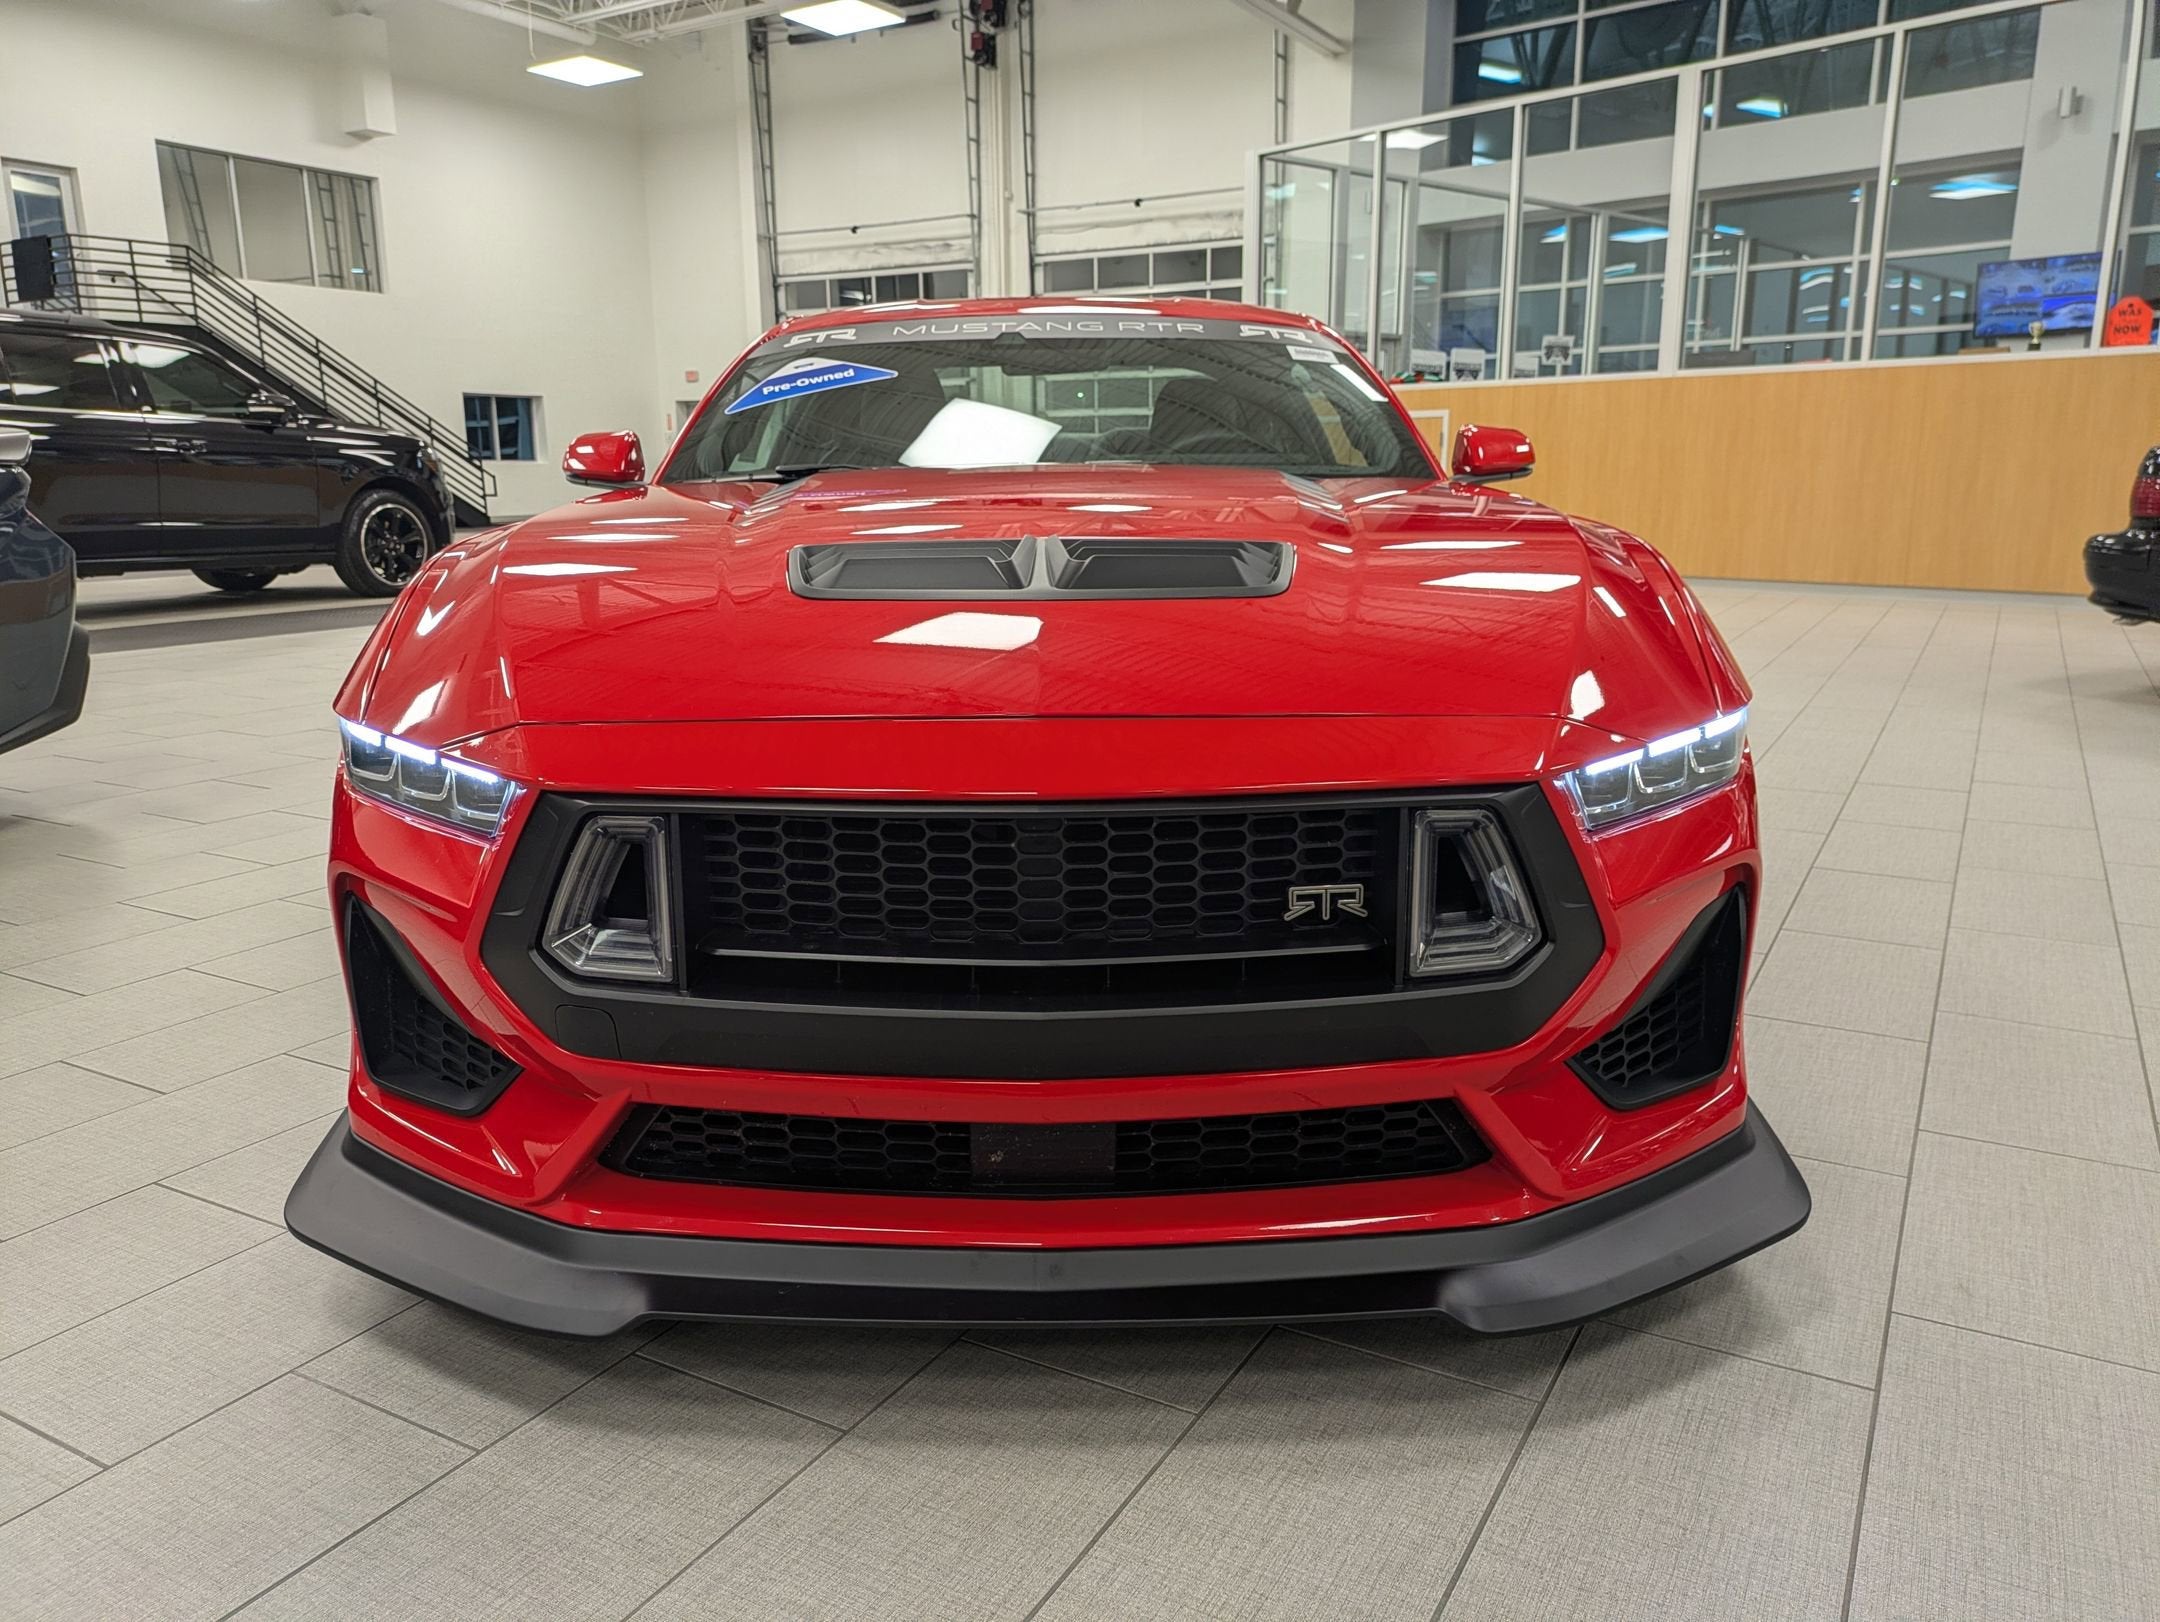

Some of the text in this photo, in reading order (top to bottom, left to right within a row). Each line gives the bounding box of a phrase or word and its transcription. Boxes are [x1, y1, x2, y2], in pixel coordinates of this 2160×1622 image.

[893, 321, 1104, 336] MUSTANG
[1119, 321, 1204, 334] RTR
[762, 368, 855, 395] Pre-Owned
[1284, 884, 1368, 921] RTR
